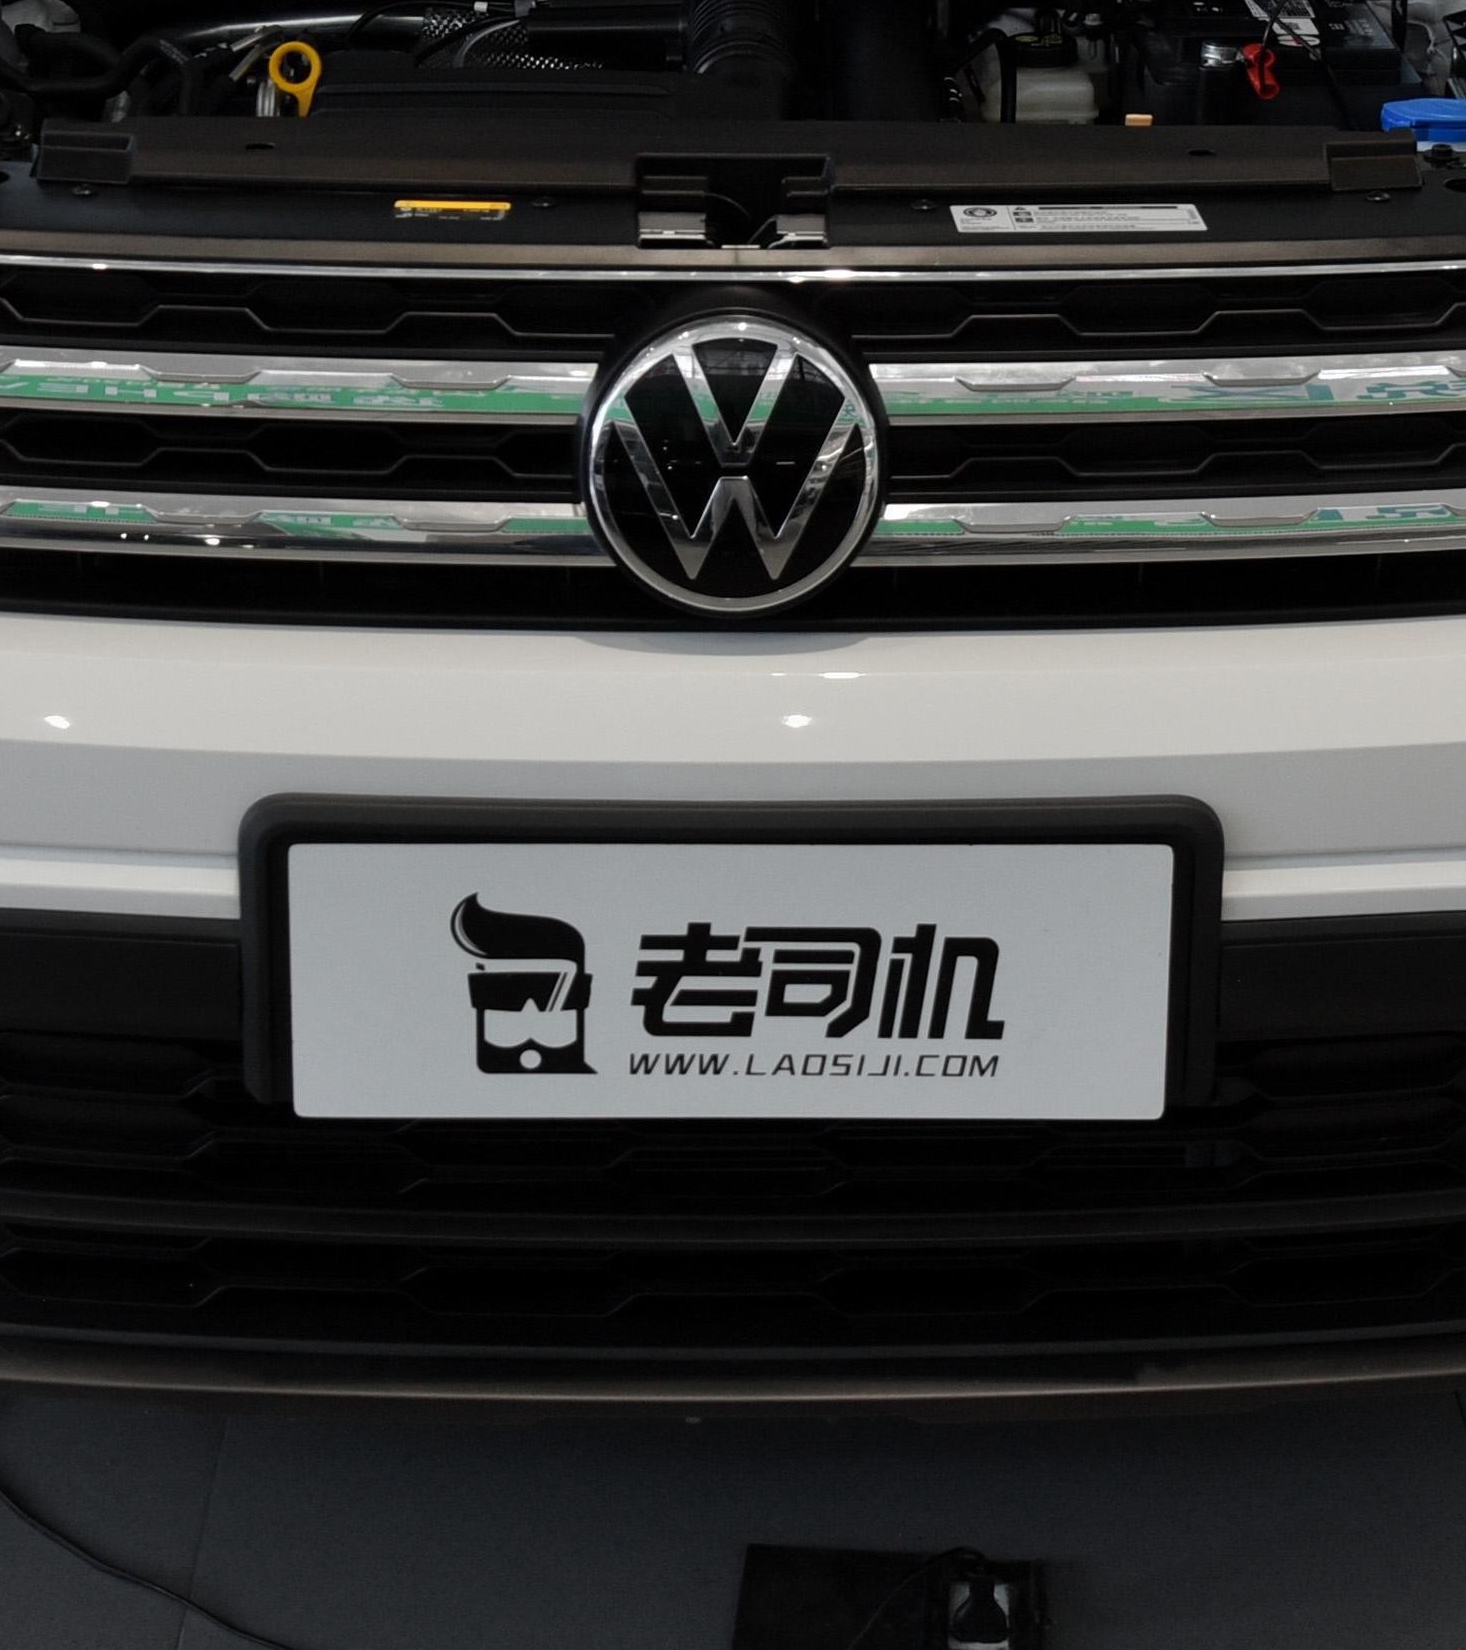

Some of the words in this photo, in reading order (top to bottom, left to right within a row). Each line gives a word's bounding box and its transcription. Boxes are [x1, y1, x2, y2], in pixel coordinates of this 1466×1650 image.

[631, 922, 1005, 1040] 老司机
[629, 1053, 1000, 1078] WWW.LAOSIJI.COM
